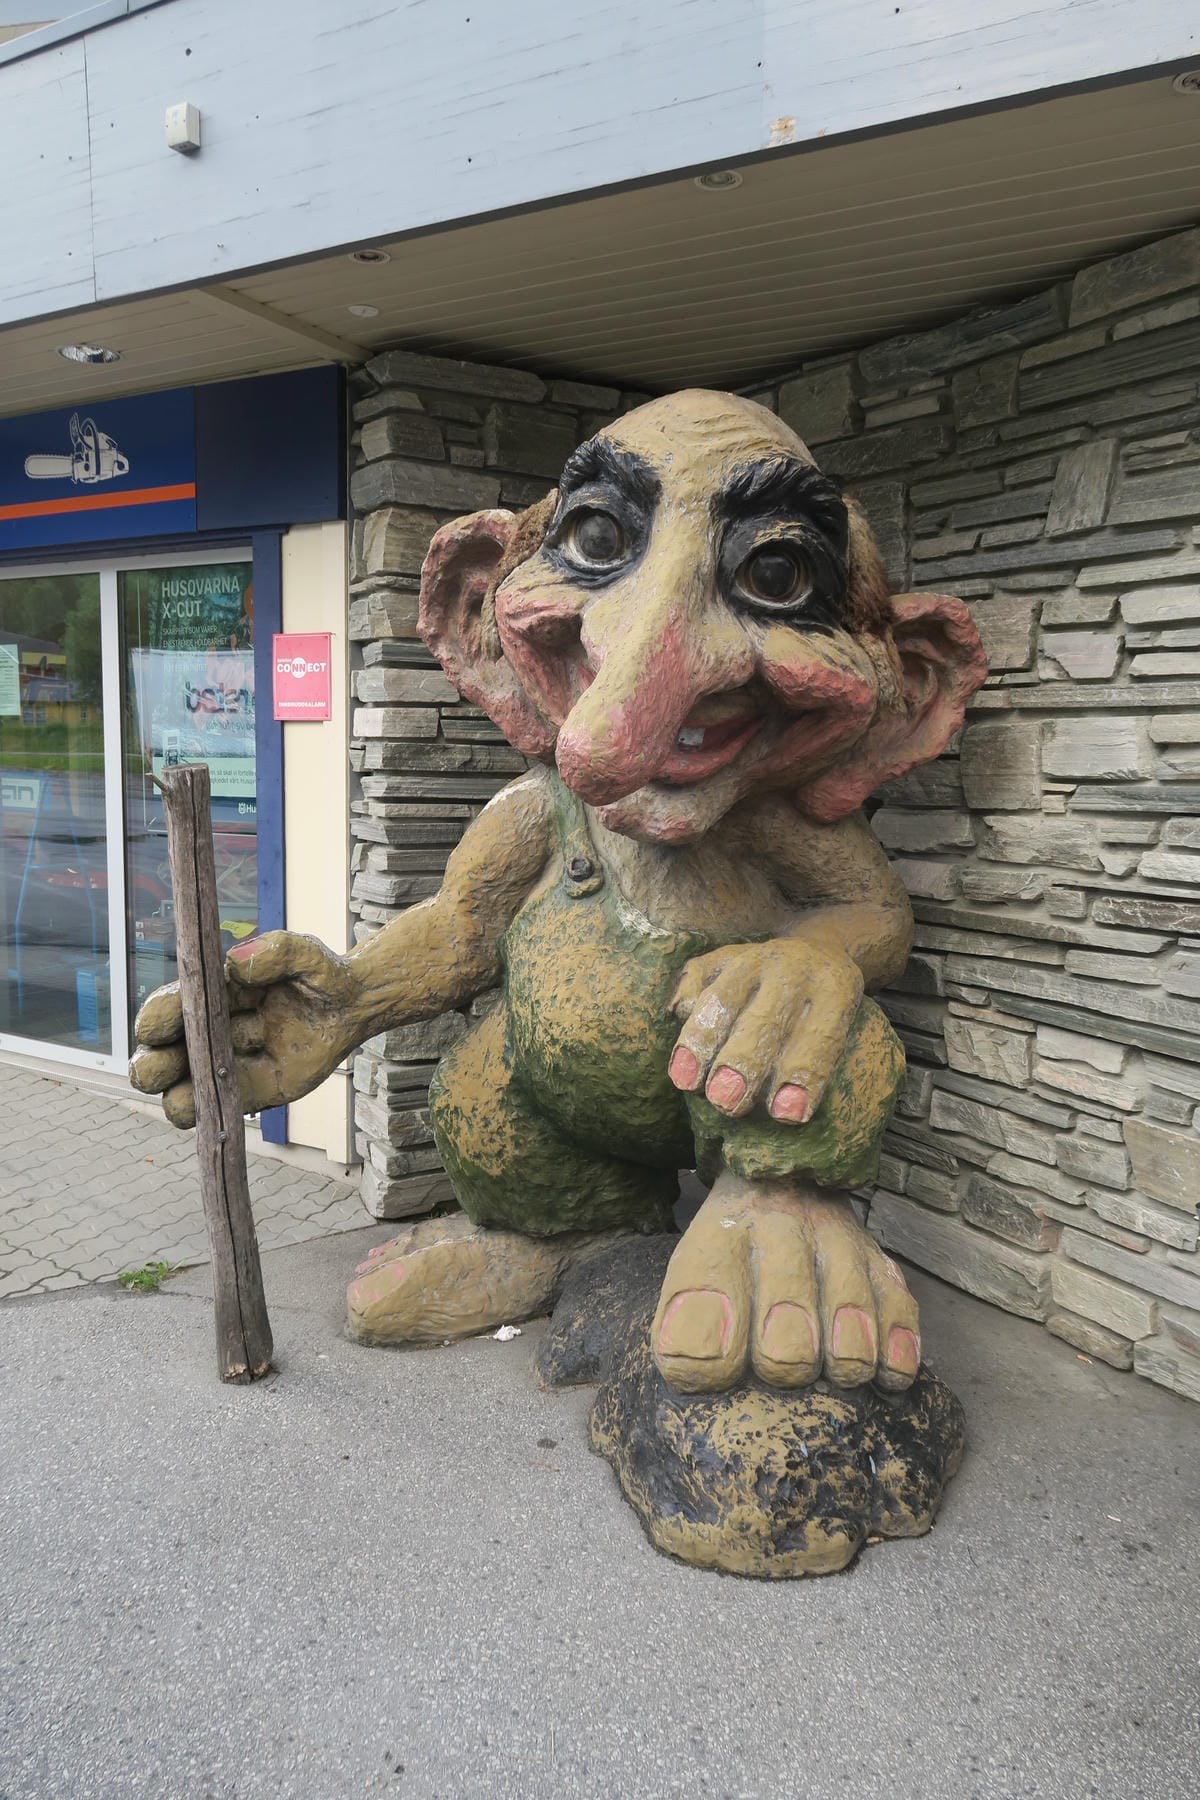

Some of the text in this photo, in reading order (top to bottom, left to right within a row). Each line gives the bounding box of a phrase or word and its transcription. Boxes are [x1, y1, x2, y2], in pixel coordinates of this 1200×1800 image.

[161, 576, 240, 598] HUSQVARNA
[162, 600, 202, 619] X-CUT
[277, 662, 326, 673] CONNECT
